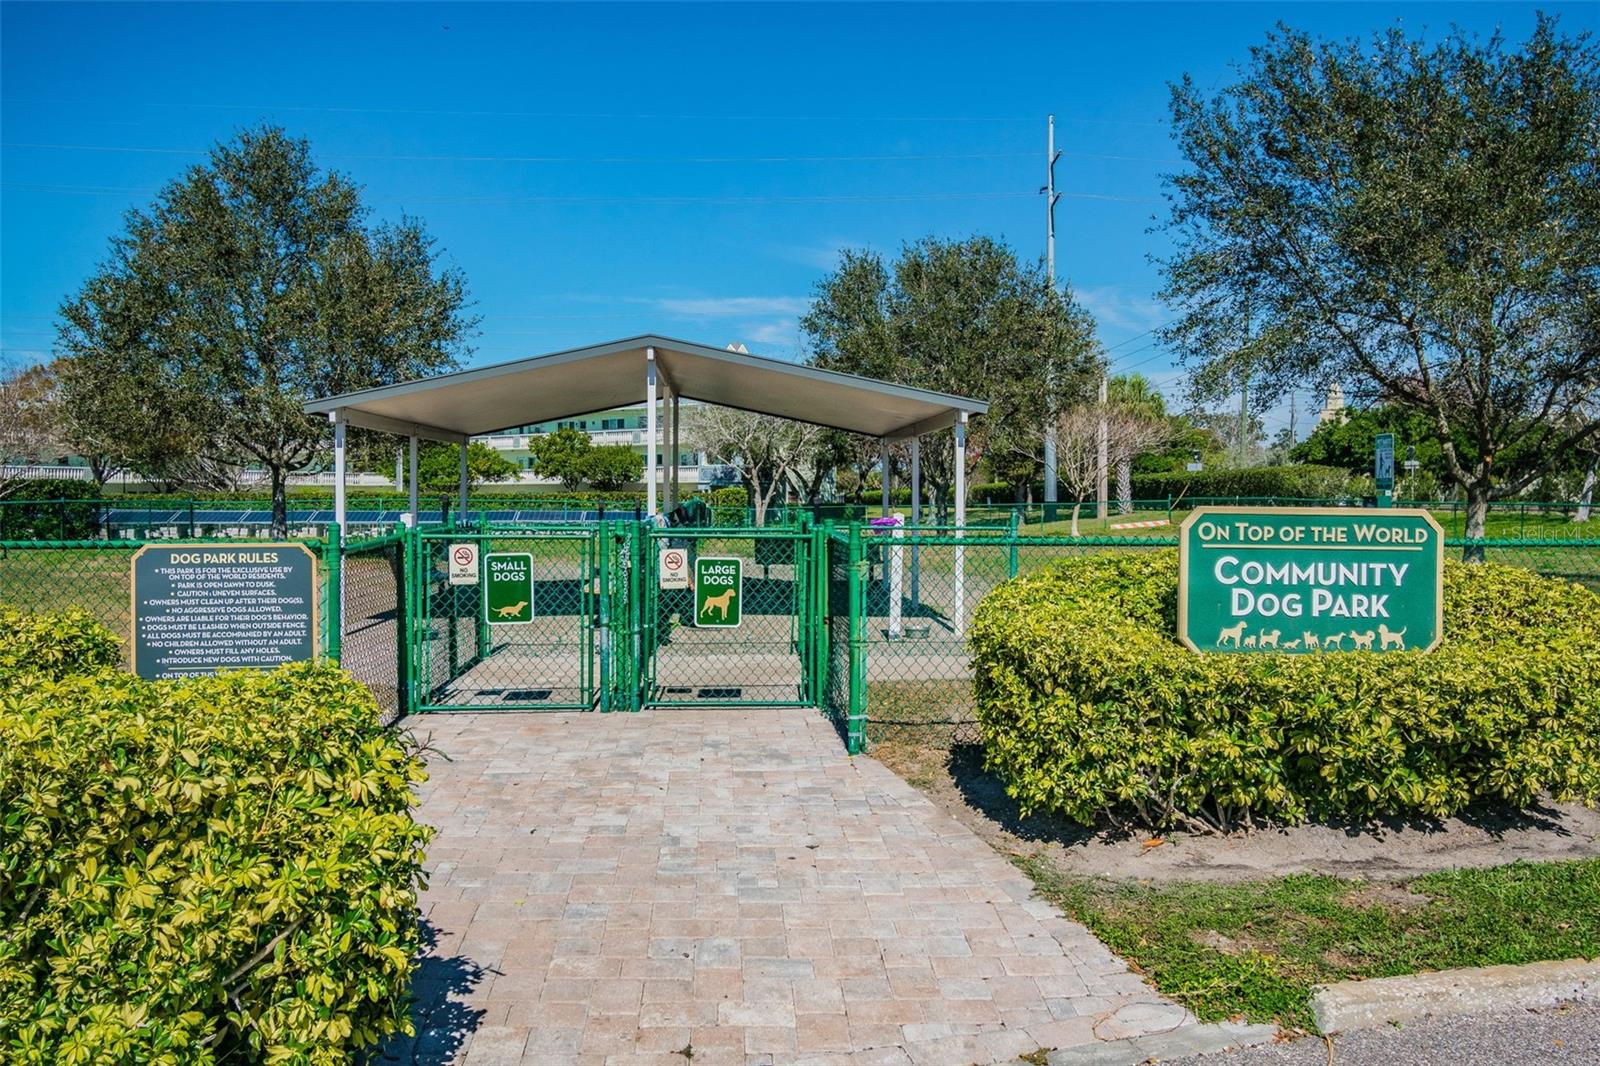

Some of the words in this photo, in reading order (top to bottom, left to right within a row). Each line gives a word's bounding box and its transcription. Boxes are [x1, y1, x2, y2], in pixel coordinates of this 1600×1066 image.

[1198, 521, 1230, 542] ON
[1235, 522, 1274, 542] TOP
[1279, 526, 1306, 542] OF
[1311, 526, 1348, 543] THE
[1352, 523, 1428, 544] WORLD
[170, 553, 201, 564] DOG
[203, 553, 236, 564] PARK
[239, 552, 279, 564] RULES
[491, 561, 527, 571] SMALL
[701, 565, 736, 575] LARGE
[1214, 556, 1410, 587] COMMUNITY
[493, 572, 526, 582] DOGS
[703, 575, 734, 585] DOGS
[1231, 588, 1303, 617] DOG
[1311, 588, 1390, 618] PARK
